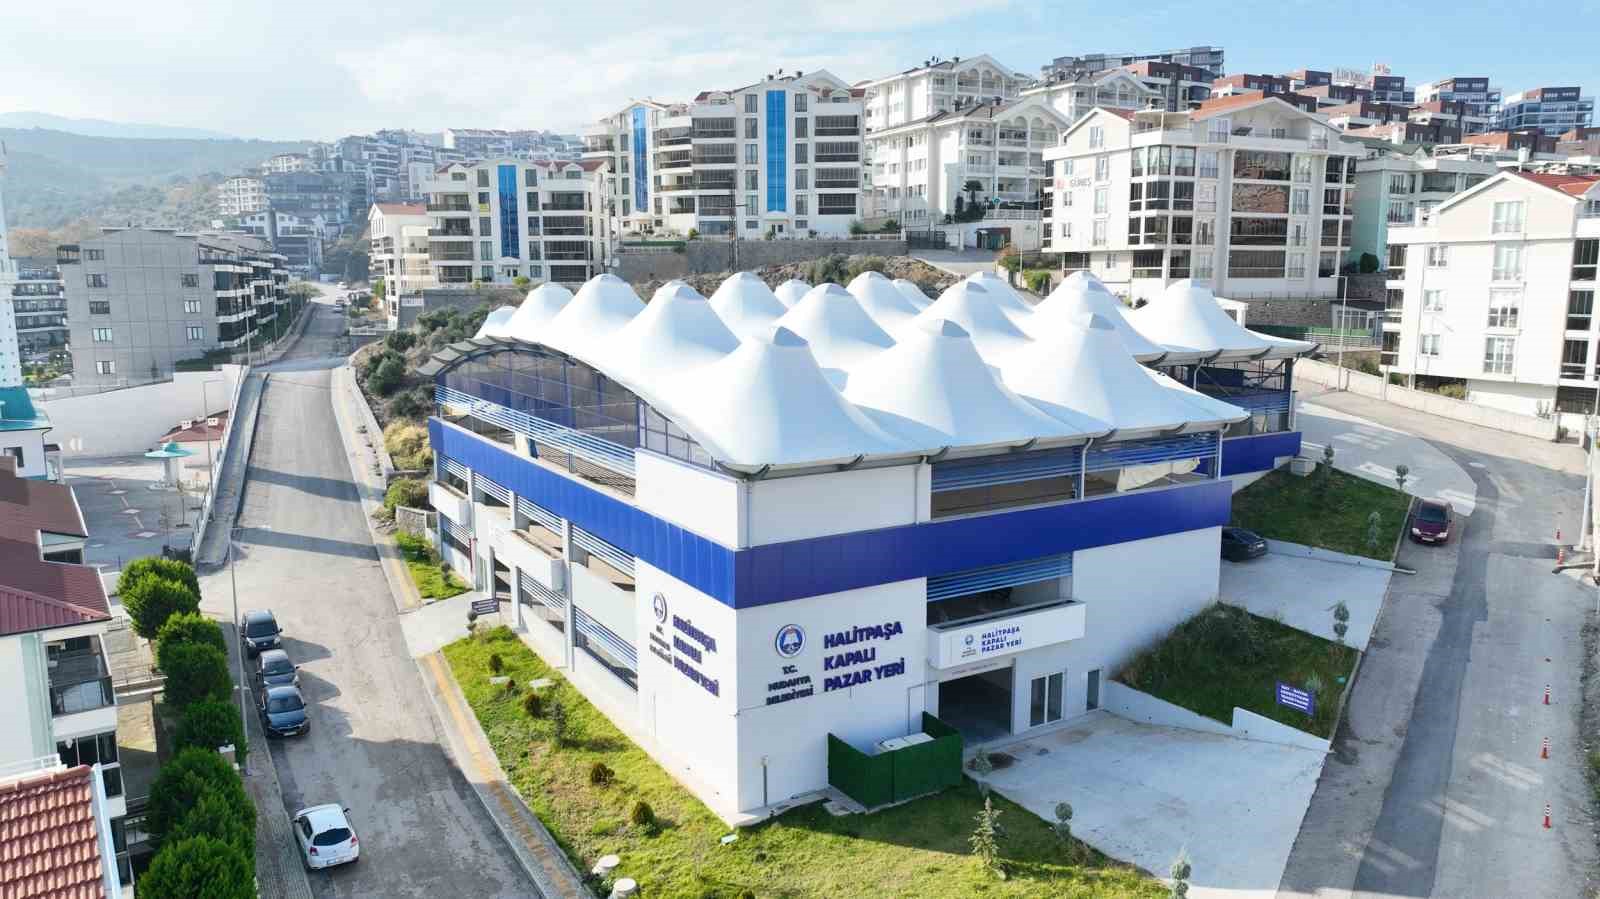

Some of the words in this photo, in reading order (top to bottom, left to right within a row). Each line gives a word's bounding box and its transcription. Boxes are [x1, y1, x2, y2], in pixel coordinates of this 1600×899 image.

[824, 621, 903, 649] HALİTPAŞA
[981, 626, 1021, 640] HALİTPAŞA
[981, 636, 1007, 647] KAPALI
[824, 647, 876, 671] KAPALI
[768, 675, 812, 692] MUDANYA
[824, 669, 872, 692] PAZAR
[873, 657, 905, 680] YERİ
